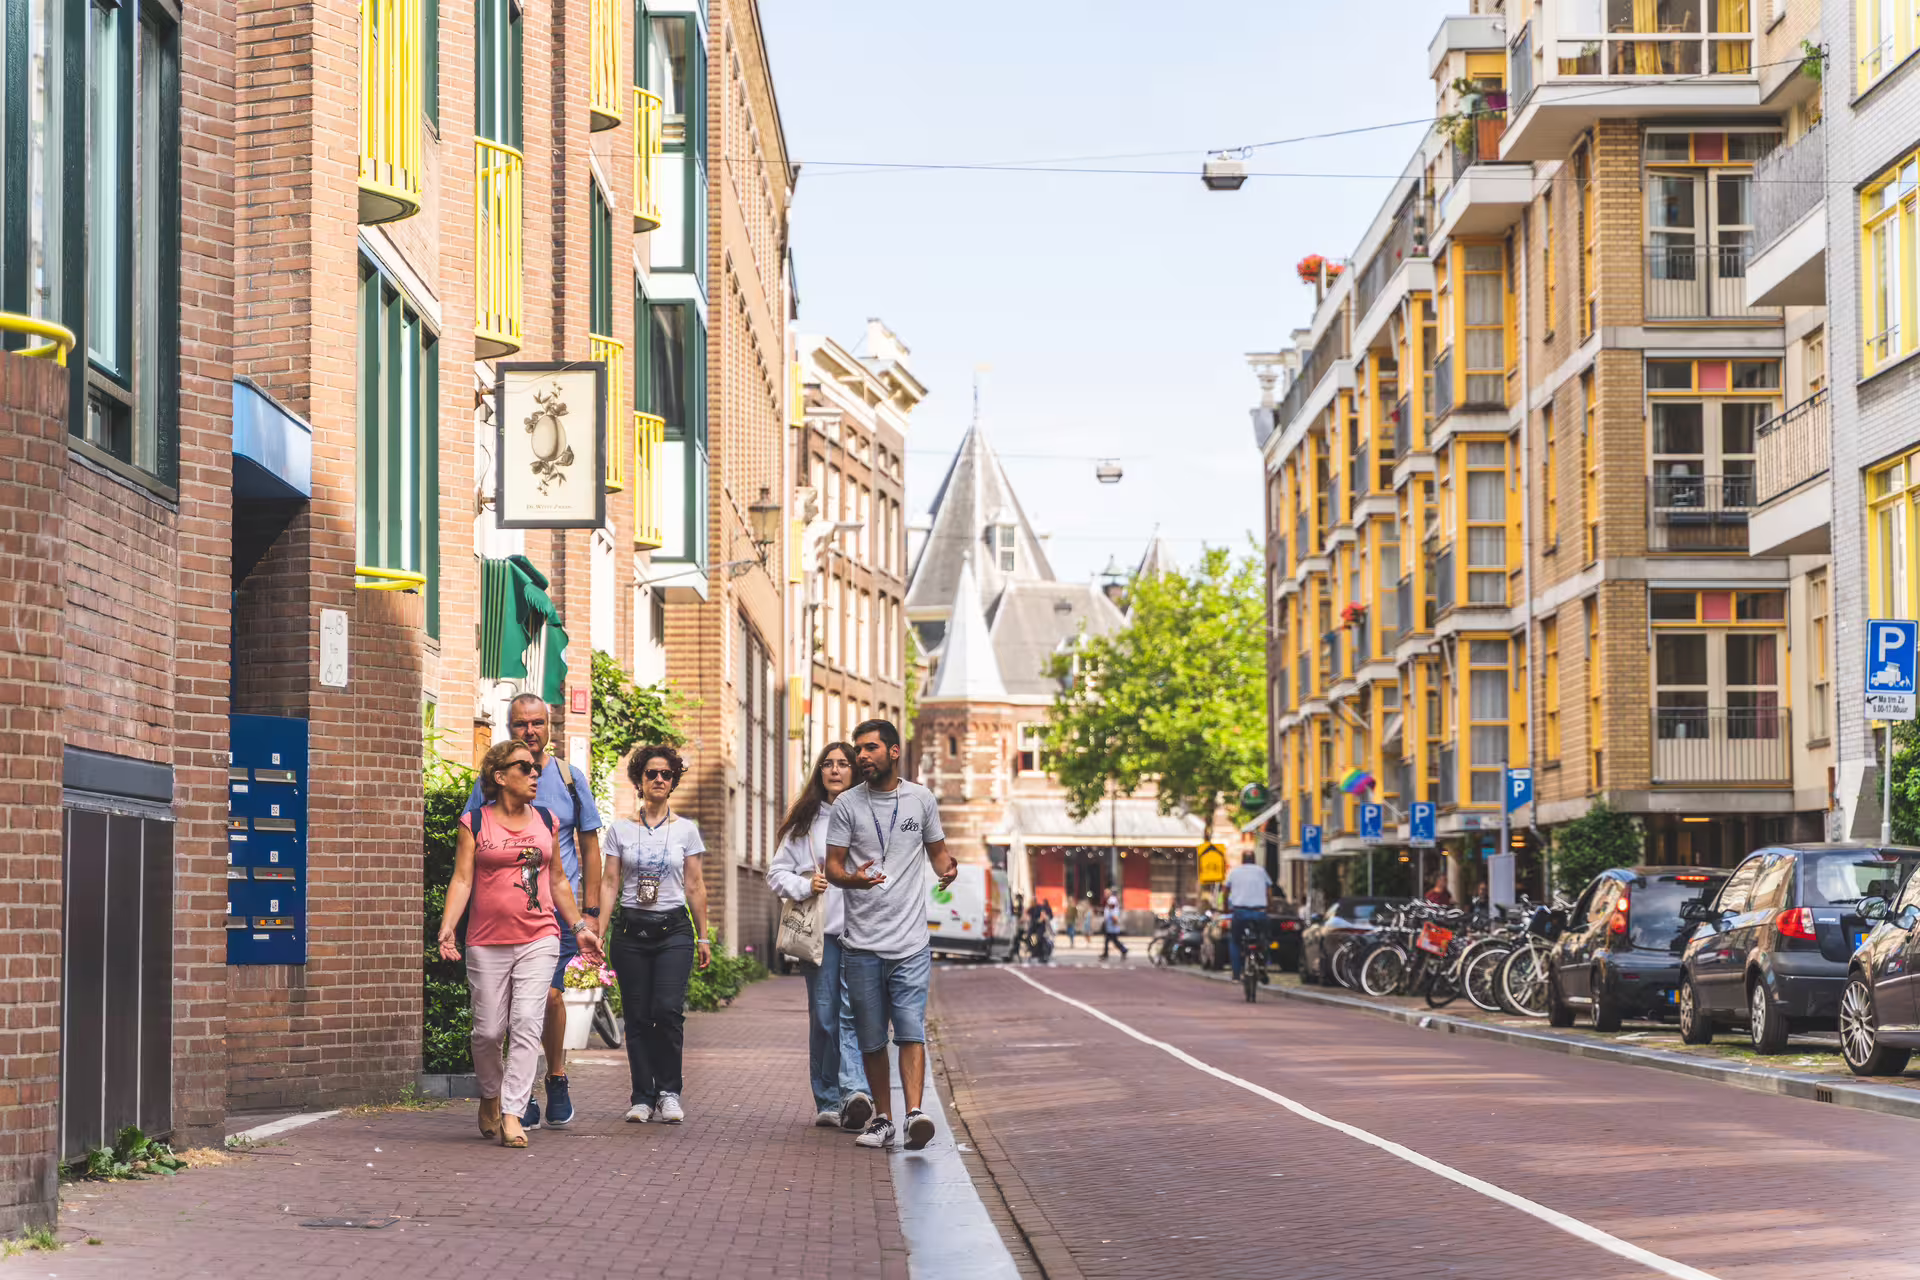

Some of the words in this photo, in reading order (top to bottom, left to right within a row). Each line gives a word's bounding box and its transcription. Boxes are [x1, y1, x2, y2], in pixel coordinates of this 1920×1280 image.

[1878, 626, 1906, 662] P
[325, 663, 343, 684] 62
[1513, 780, 1525, 799] P
[1365, 806, 1378, 823] P
[1415, 805, 1429, 824] P
[1305, 826, 1317, 842] P
[479, 839, 498, 853] Be
